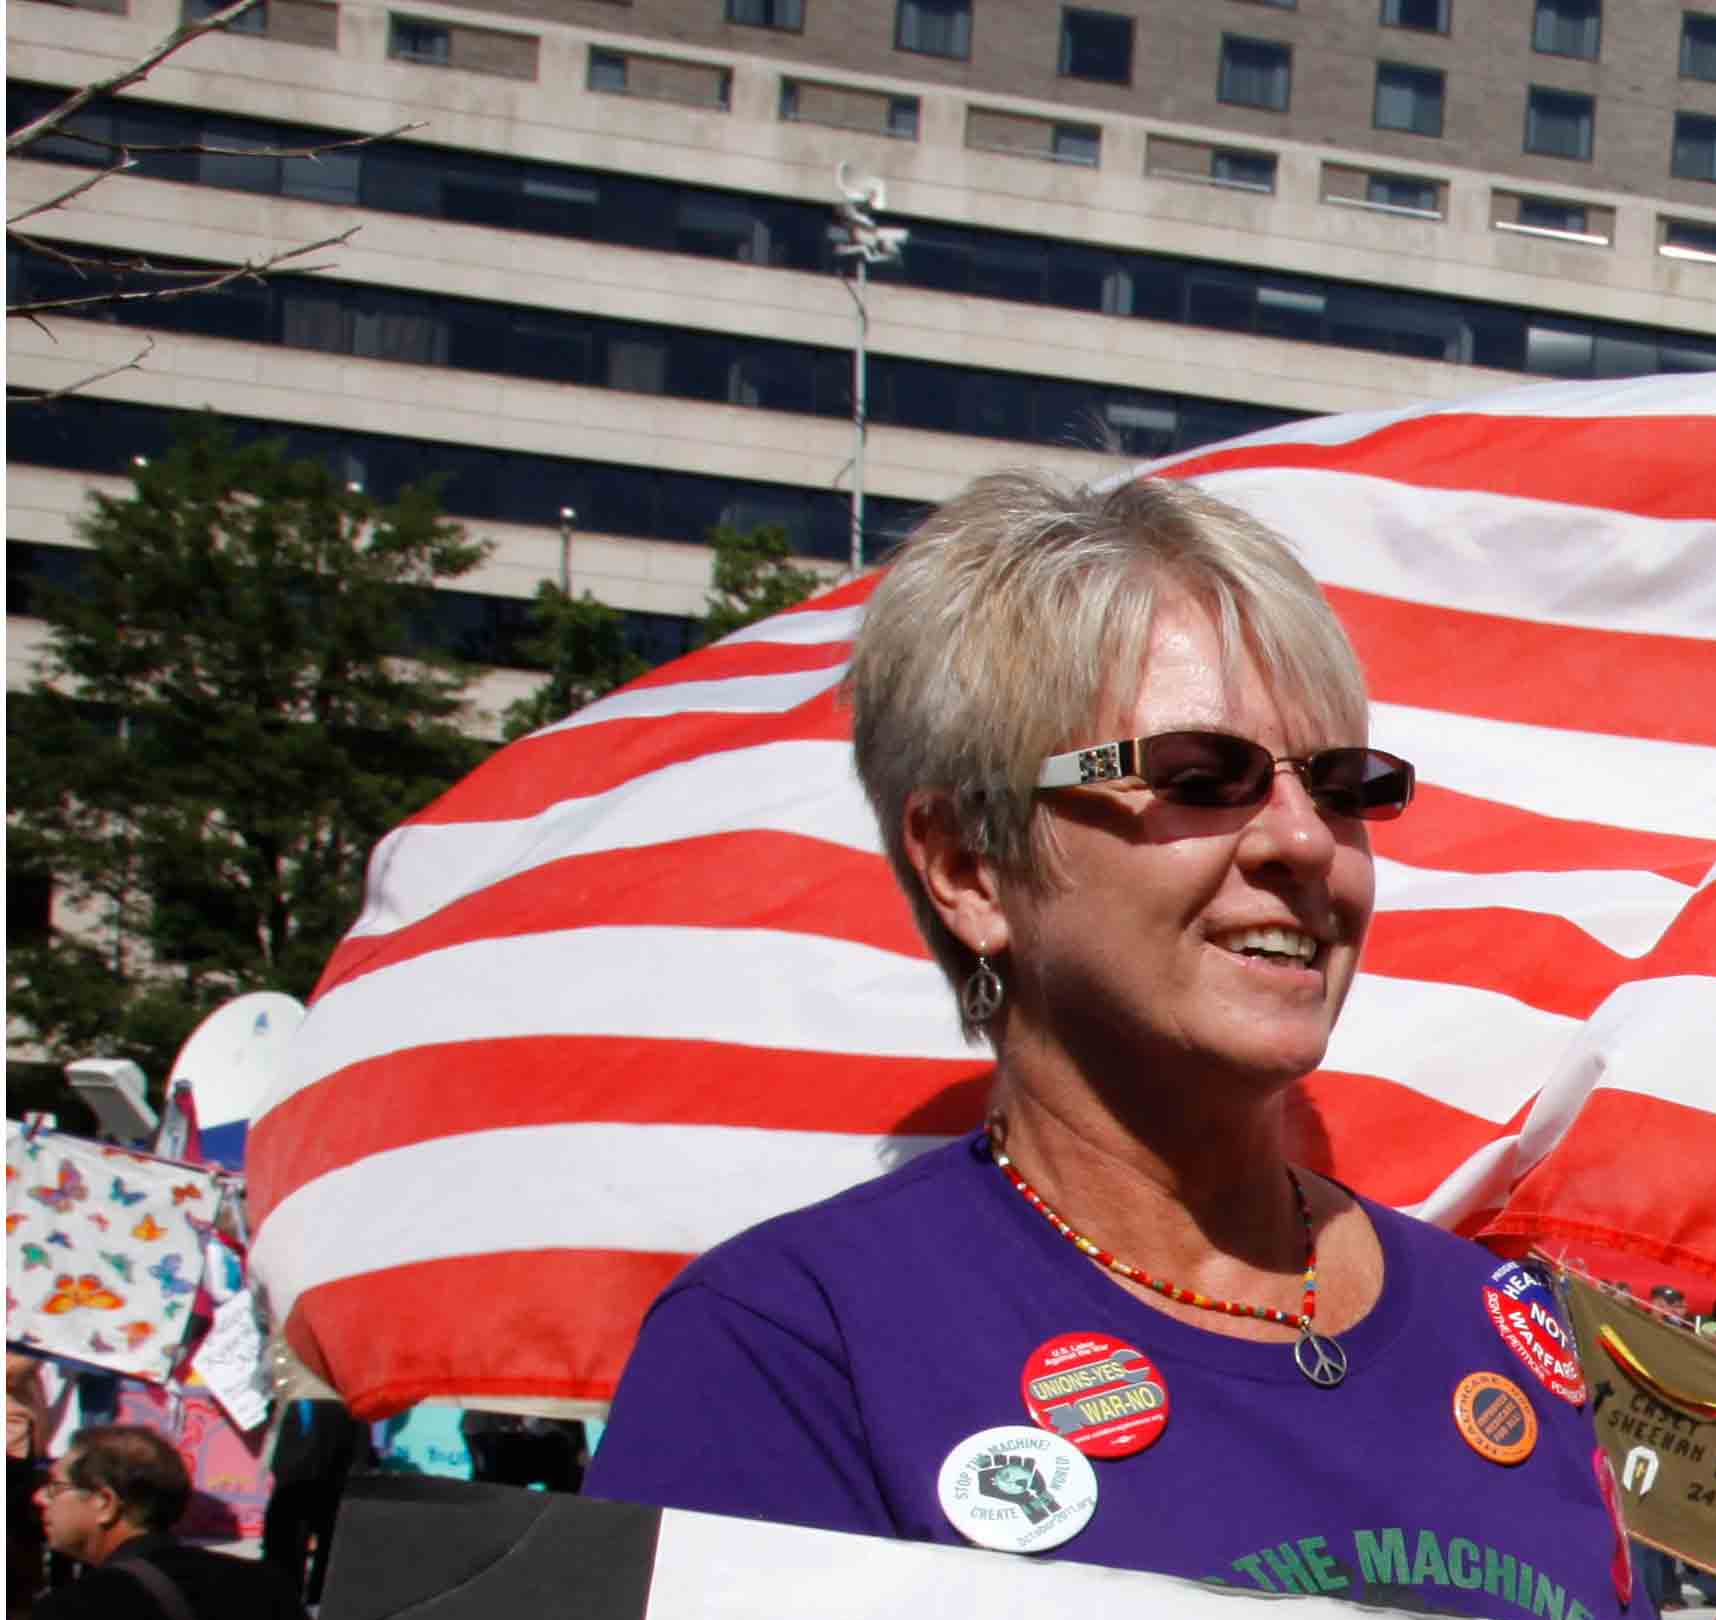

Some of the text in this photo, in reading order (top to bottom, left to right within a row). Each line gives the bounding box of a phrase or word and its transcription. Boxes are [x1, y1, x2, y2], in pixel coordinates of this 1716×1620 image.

[1531, 1302, 1568, 1348] NOT
[1031, 1361, 1126, 1400] UNIONS-YES
[1080, 1386, 1156, 1424] WAR-NO
[969, 1504, 1020, 1521] CREATE
[1687, 1481, 1716, 1506] 24
[1231, 1535, 1350, 1594] THE
